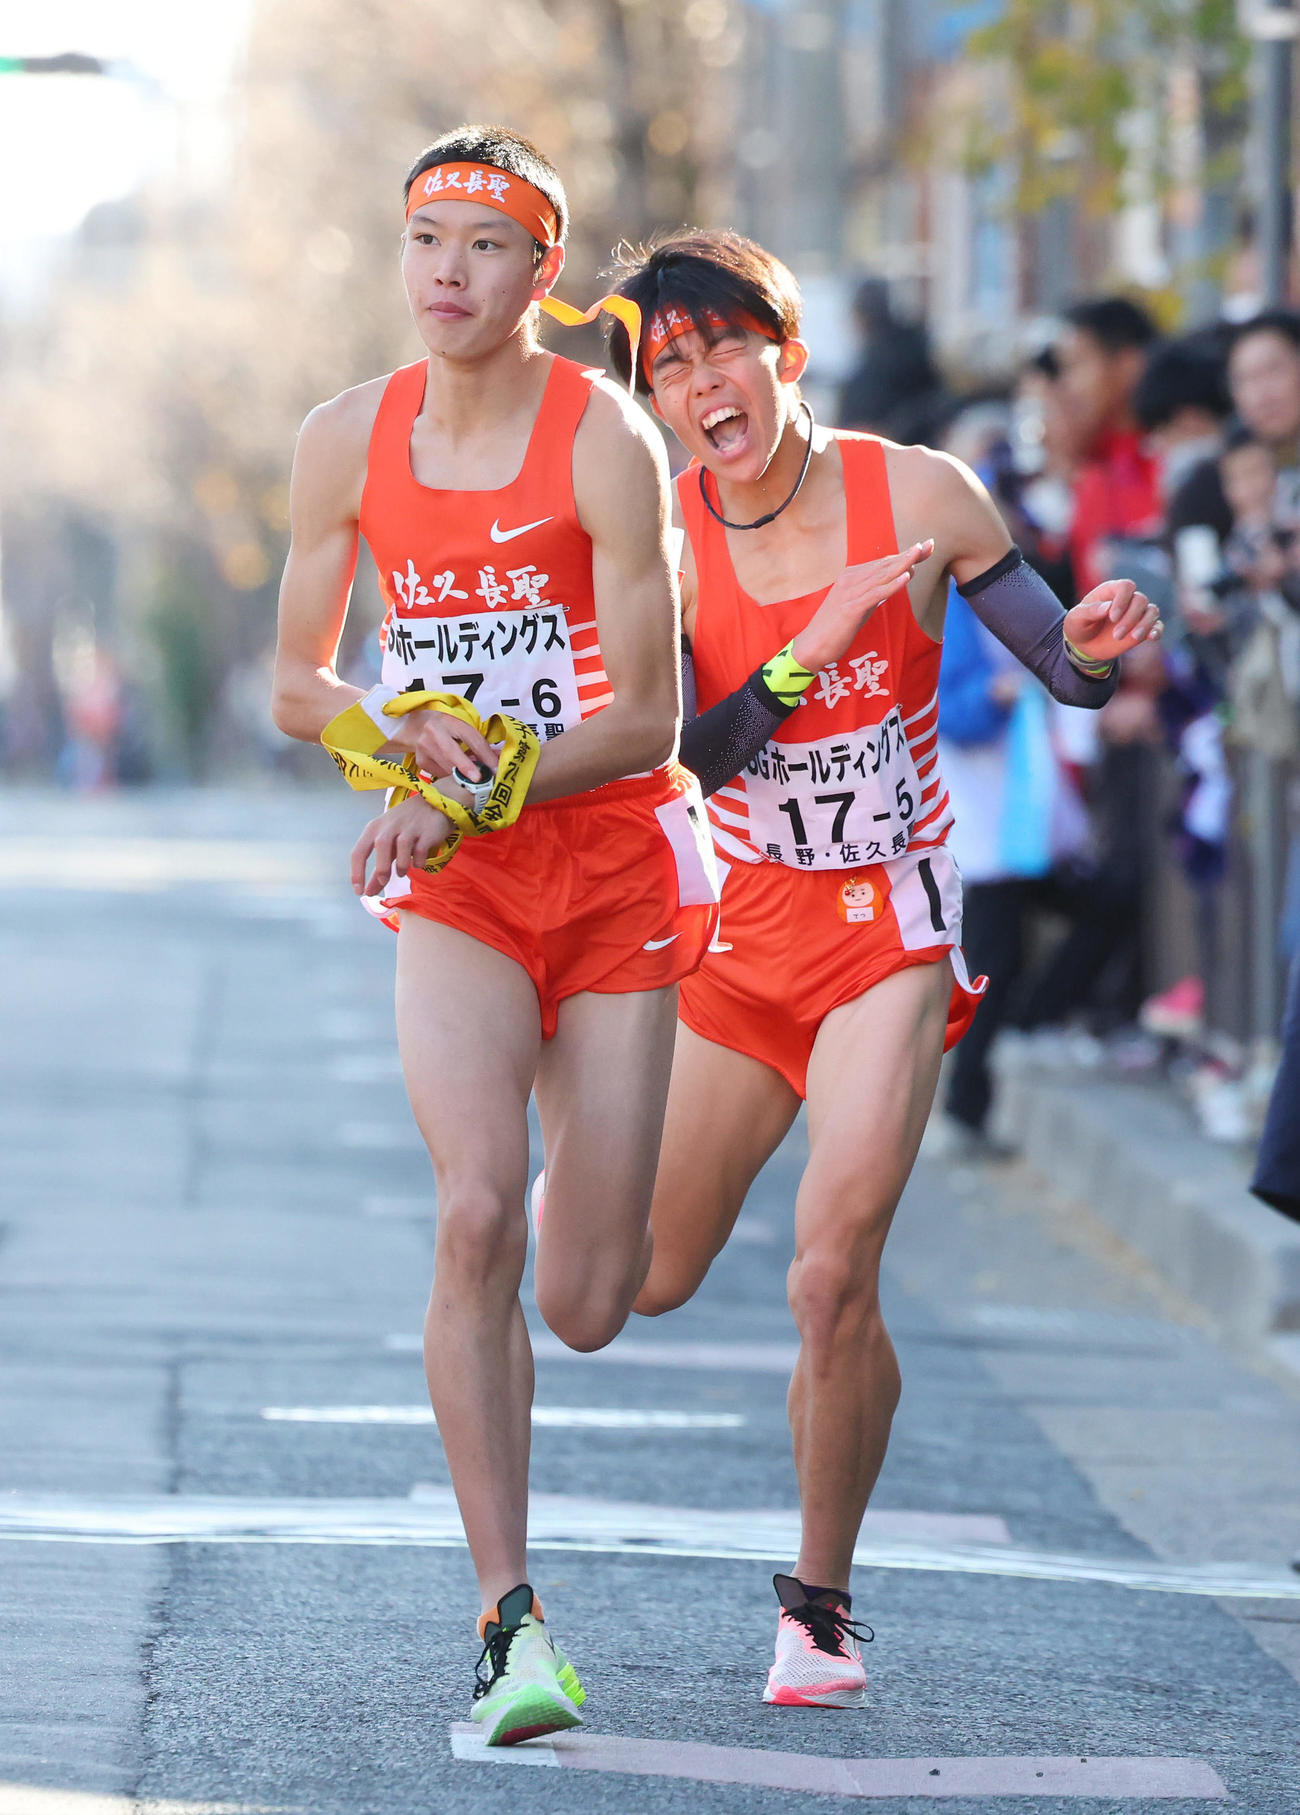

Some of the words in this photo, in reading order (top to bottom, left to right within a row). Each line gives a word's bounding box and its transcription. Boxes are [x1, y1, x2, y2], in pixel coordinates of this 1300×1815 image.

[423, 168, 511, 203] 佐久長聖
[392, 558, 551, 610] 佐久長聖
